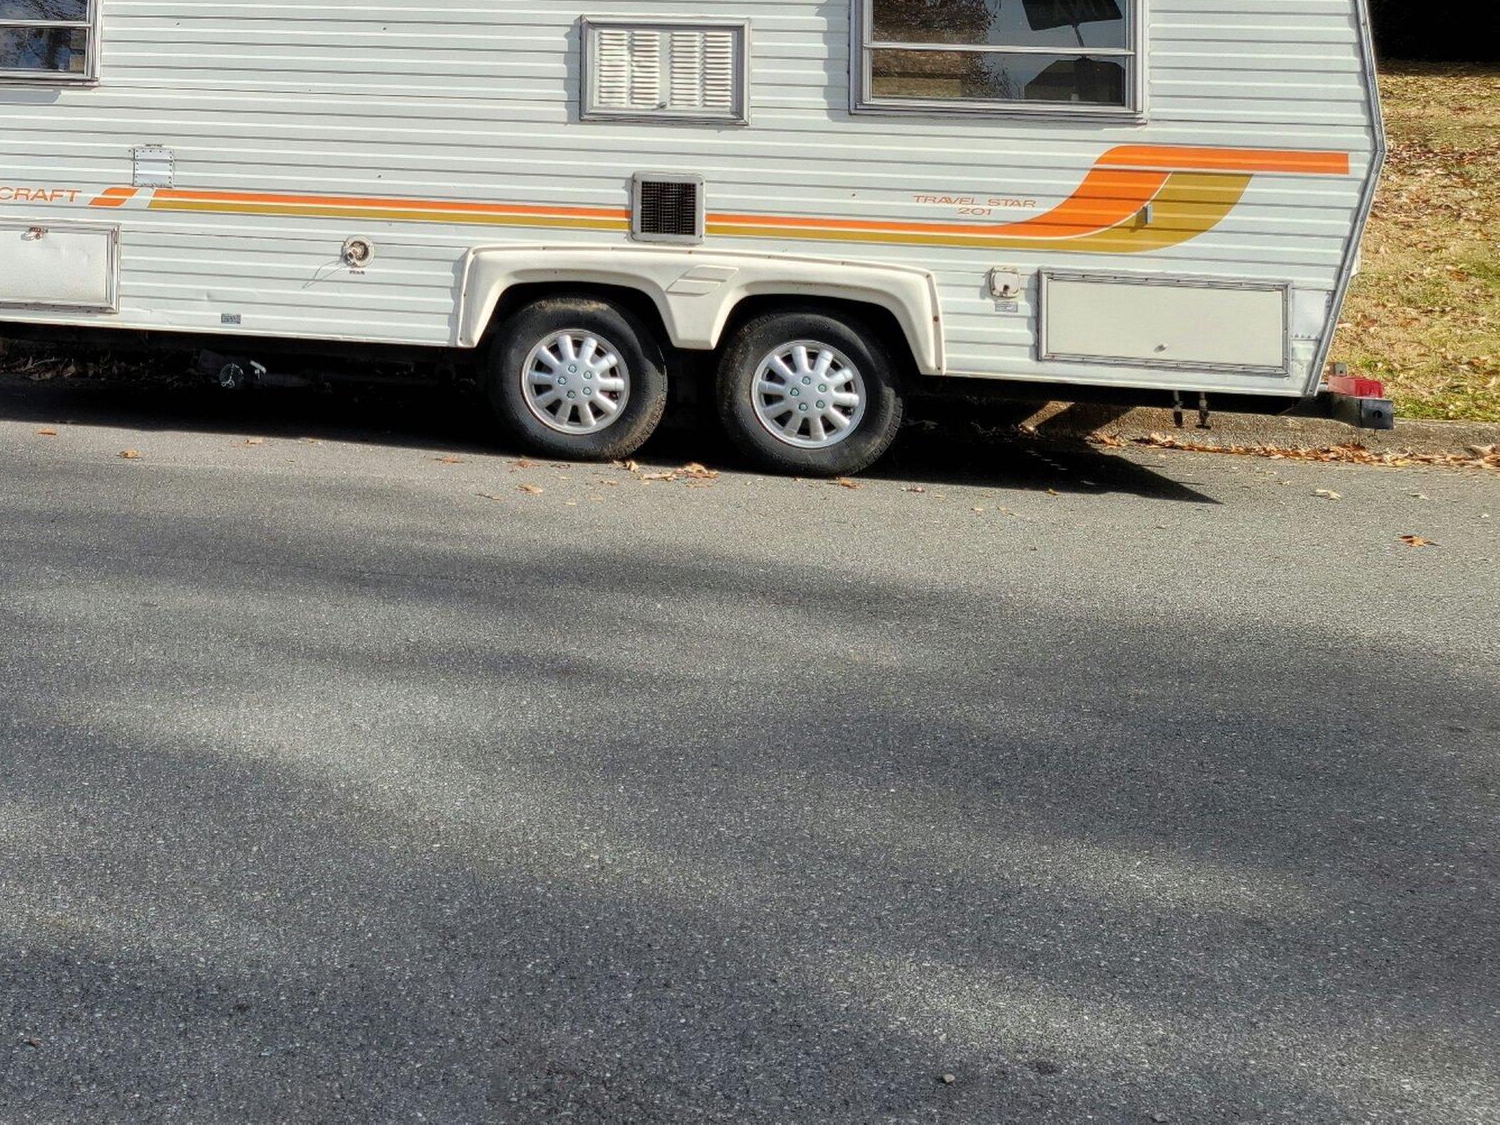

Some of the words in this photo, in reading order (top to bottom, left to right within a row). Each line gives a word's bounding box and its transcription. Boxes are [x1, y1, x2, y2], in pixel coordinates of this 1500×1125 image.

[913, 195, 981, 206] TRAVEL
[987, 198, 1037, 208] STAR
[957, 207, 992, 216] 201
